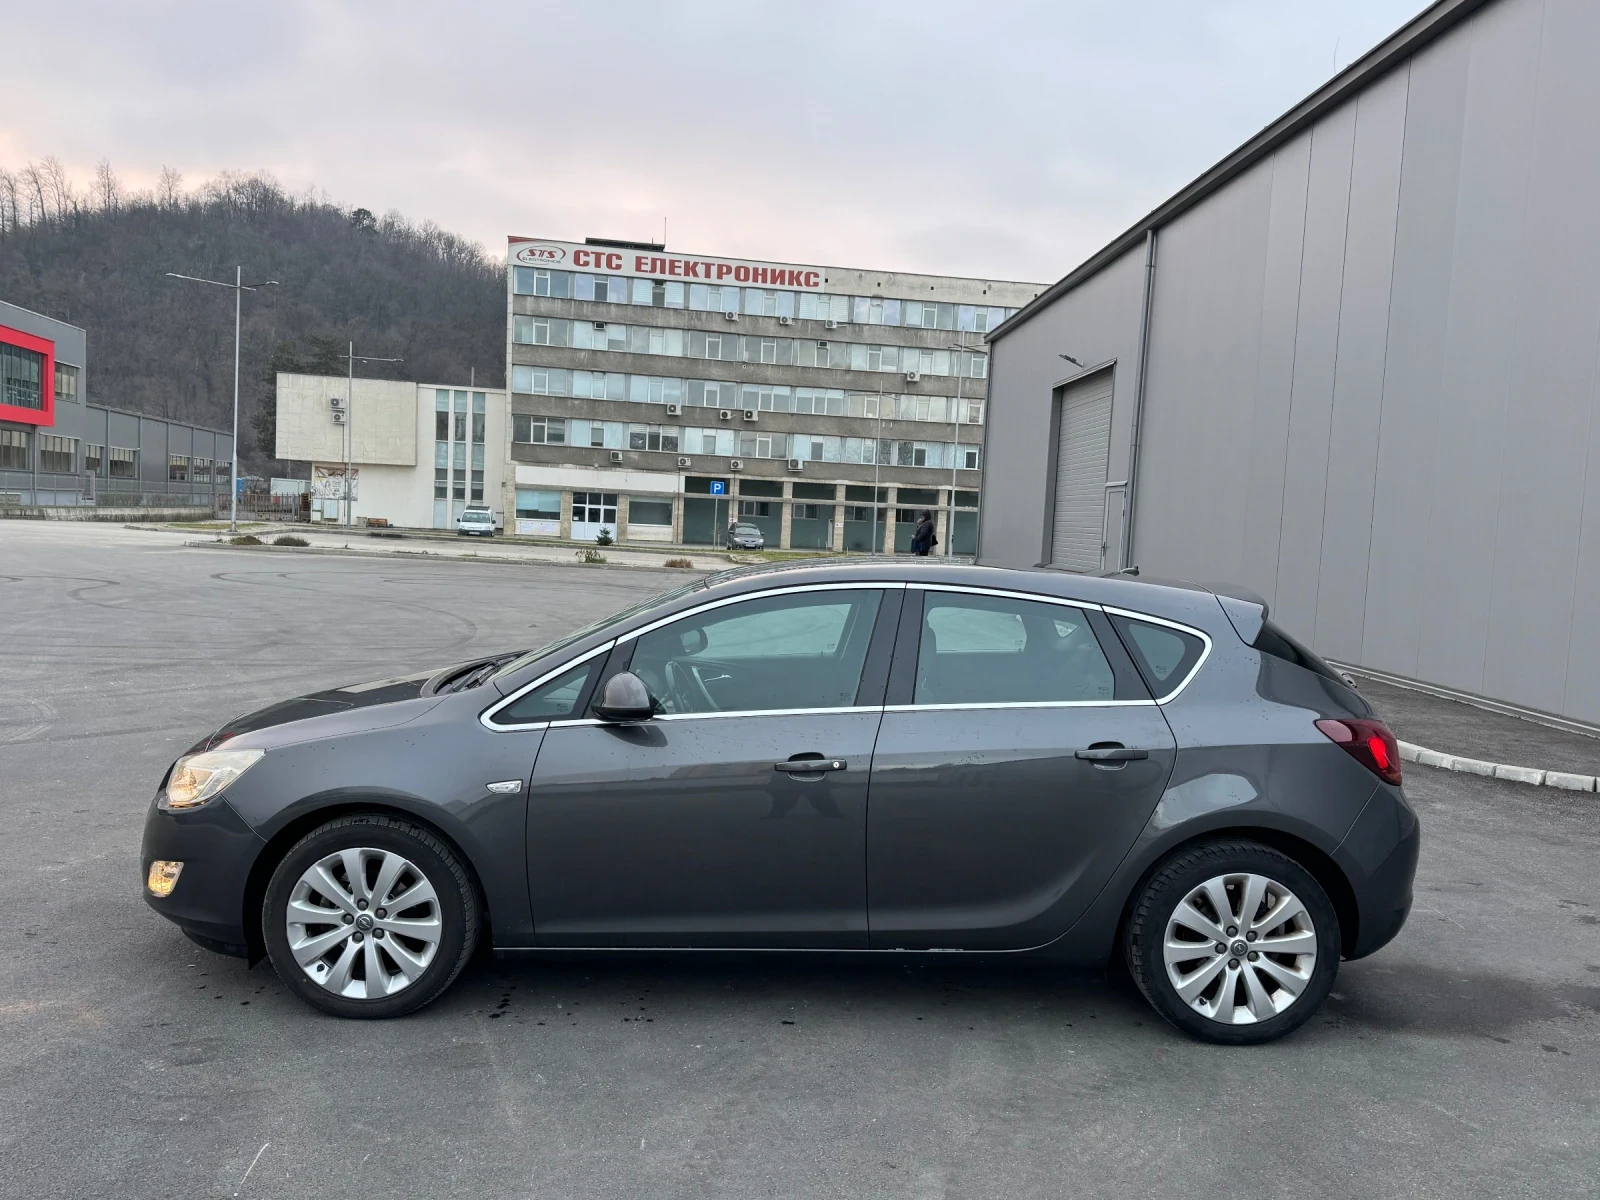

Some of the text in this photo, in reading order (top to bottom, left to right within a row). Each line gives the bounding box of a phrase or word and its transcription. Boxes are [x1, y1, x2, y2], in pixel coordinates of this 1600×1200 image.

[527, 249, 556, 258] STS
[573, 249, 820, 287] СТС ЕЛЕКТРОНИКС
[713, 483, 722, 493] P
